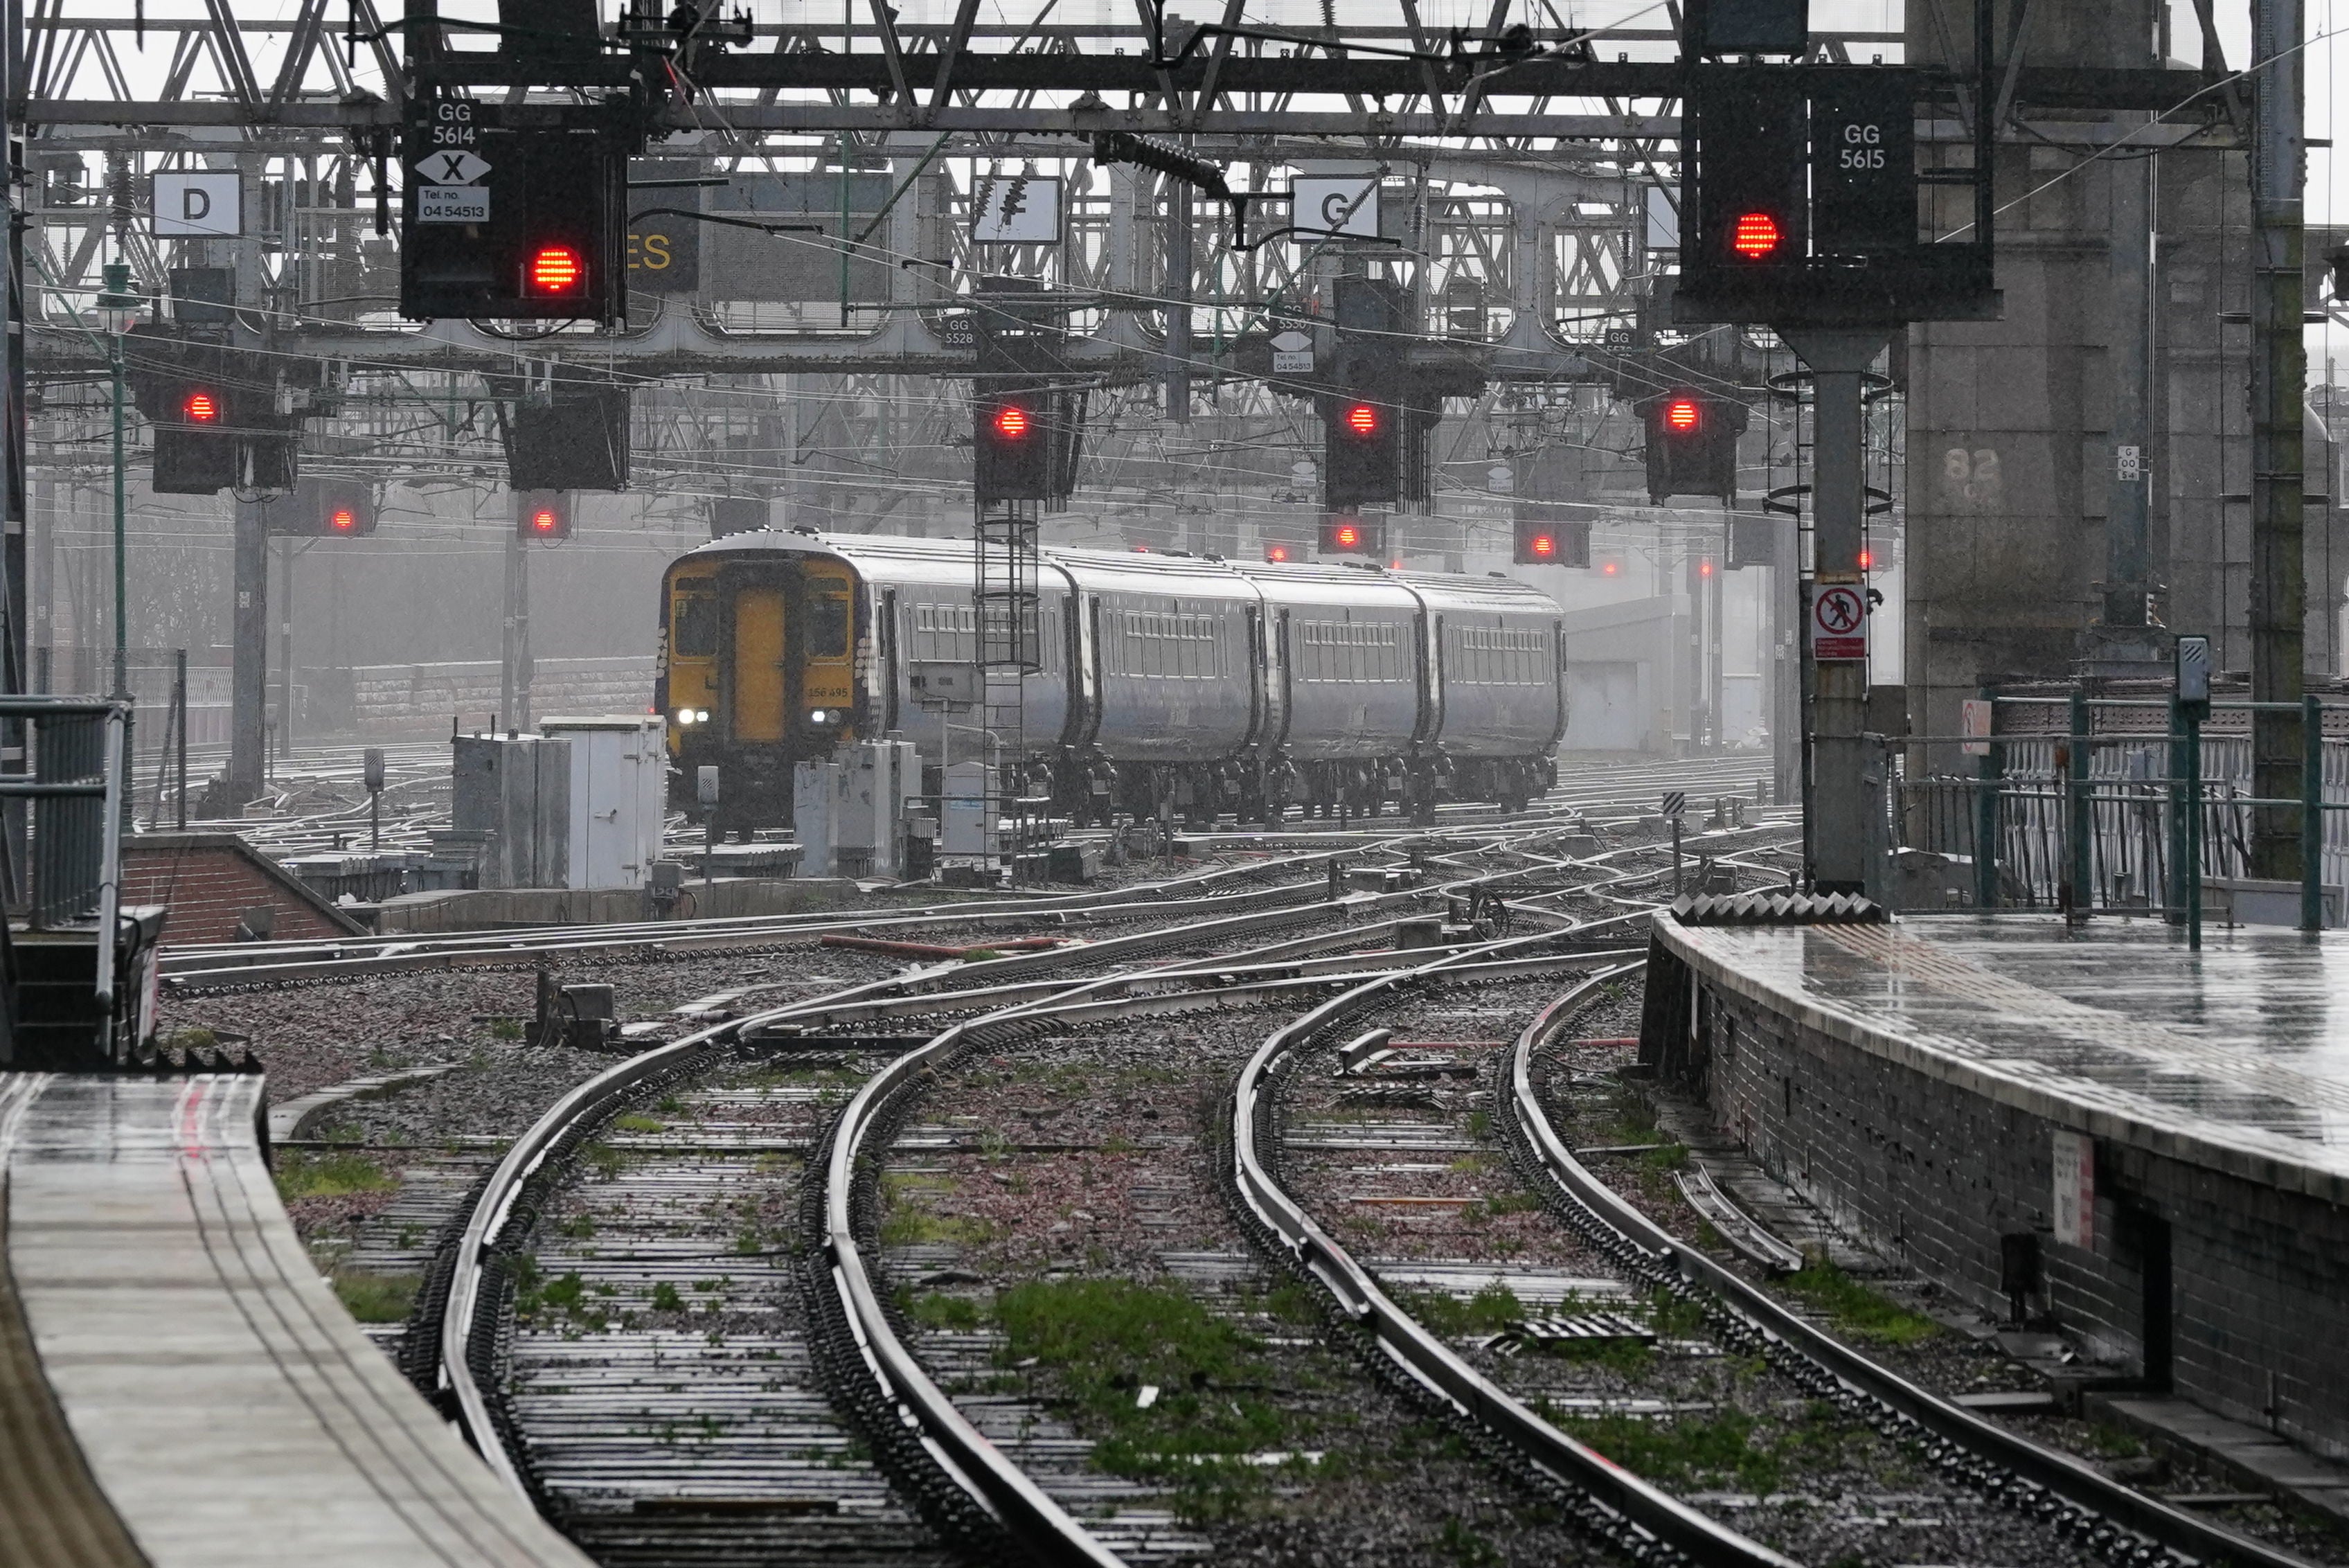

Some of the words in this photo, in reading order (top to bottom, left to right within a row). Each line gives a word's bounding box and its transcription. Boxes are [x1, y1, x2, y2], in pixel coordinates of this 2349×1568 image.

[438, 103, 472, 121] GG
[432, 126, 476, 145] 5614
[1844, 125, 1880, 144] GG
[441, 154, 466, 181] X
[1839, 149, 1885, 168] 5615
[183, 188, 211, 220] D
[1321, 193, 1349, 226] G
[949, 319, 969, 330] GG
[945, 332, 974, 344] 5528
[1610, 332, 1629, 343] GG
[808, 687, 826, 697] 156
[830, 687, 848, 697] 495
